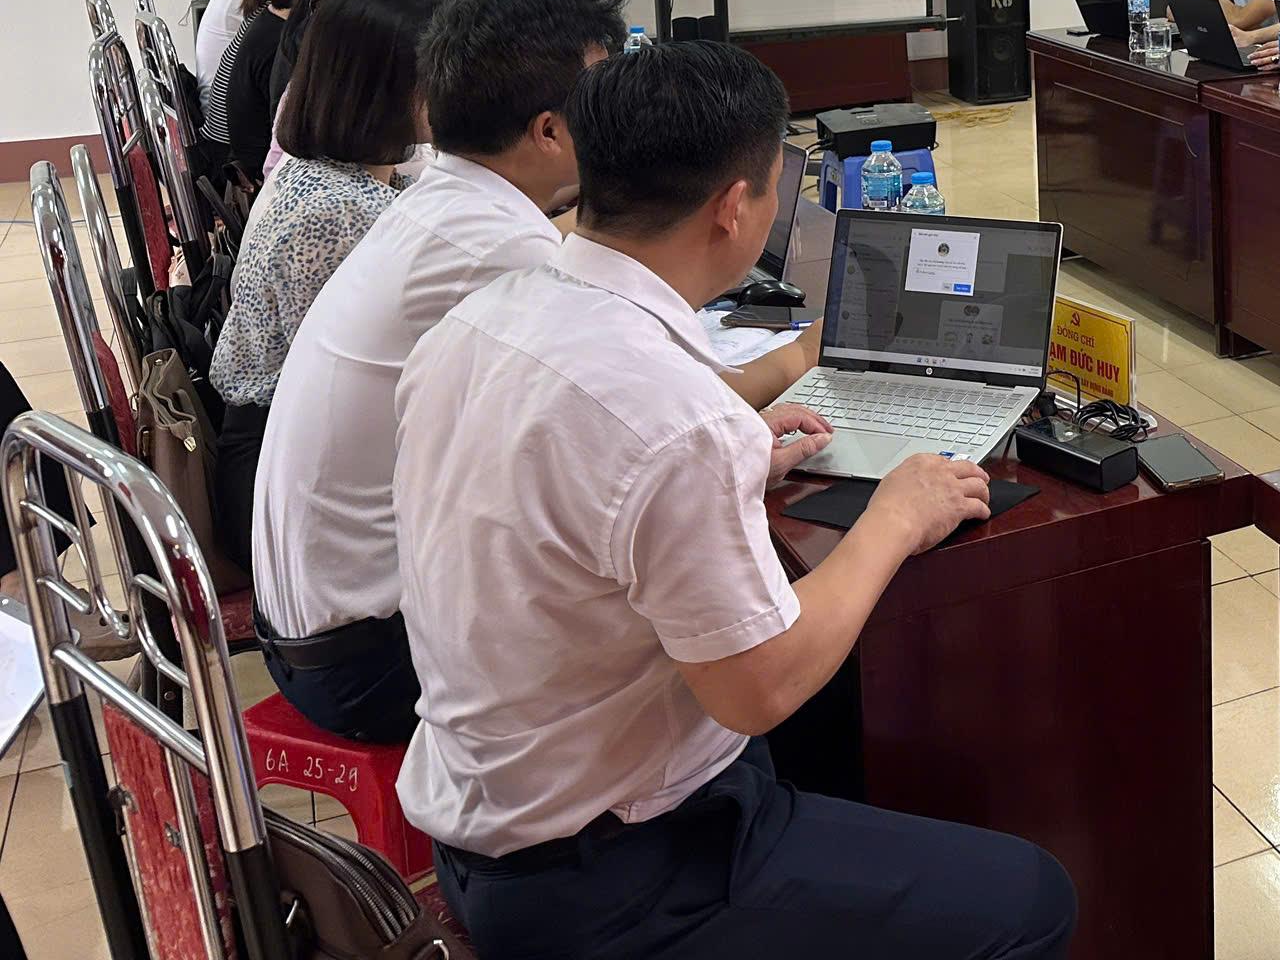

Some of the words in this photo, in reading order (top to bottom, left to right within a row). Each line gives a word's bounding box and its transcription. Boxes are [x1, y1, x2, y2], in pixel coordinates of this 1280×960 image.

[1080, 334, 1095, 348] CHÍ
[1049, 341, 1067, 361] ẠM
[1069, 347, 1094, 373] ĐỨC
[1096, 359, 1120, 383] HUY
[266, 748, 289, 772] 6A
